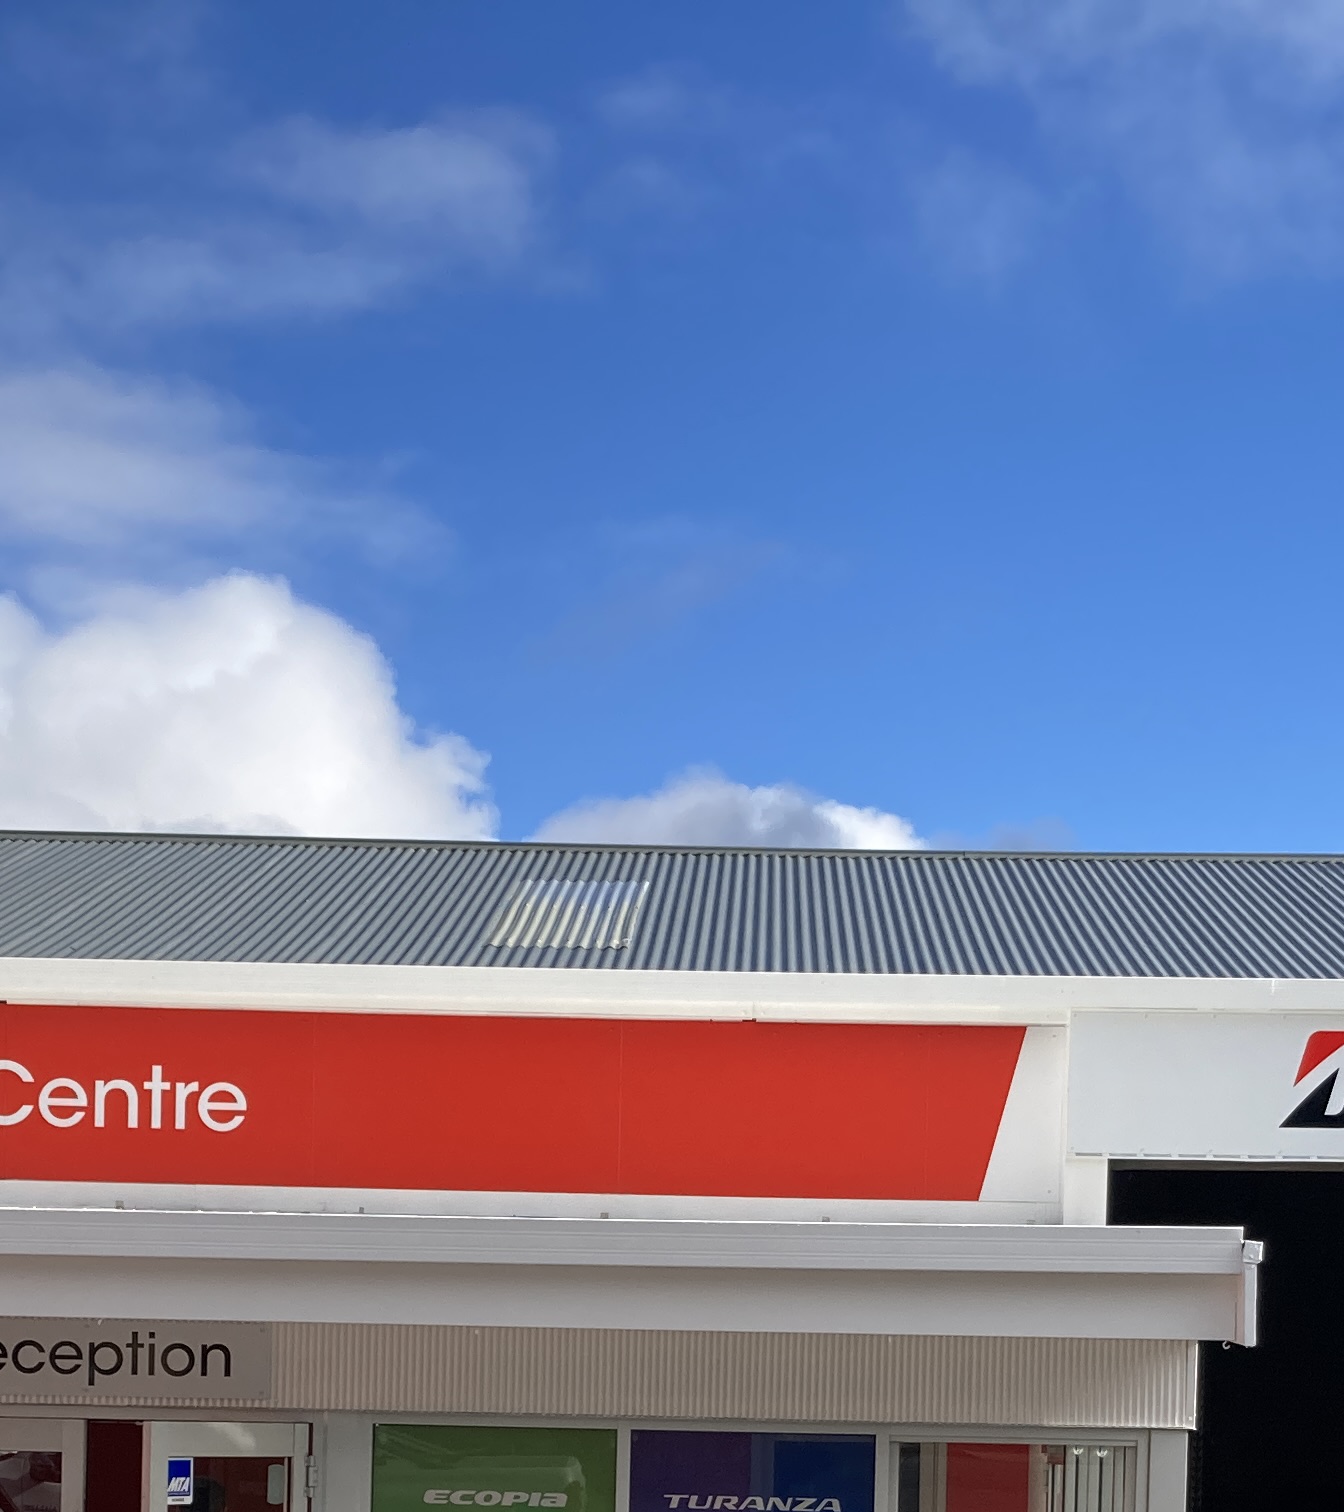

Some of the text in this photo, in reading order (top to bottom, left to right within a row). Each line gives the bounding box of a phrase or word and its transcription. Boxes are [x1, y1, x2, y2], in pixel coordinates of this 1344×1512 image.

[167, 1476, 190, 1492] MTA
[423, 1489, 568, 1507] ECOPIA
[664, 1494, 843, 1512] TURANZA
